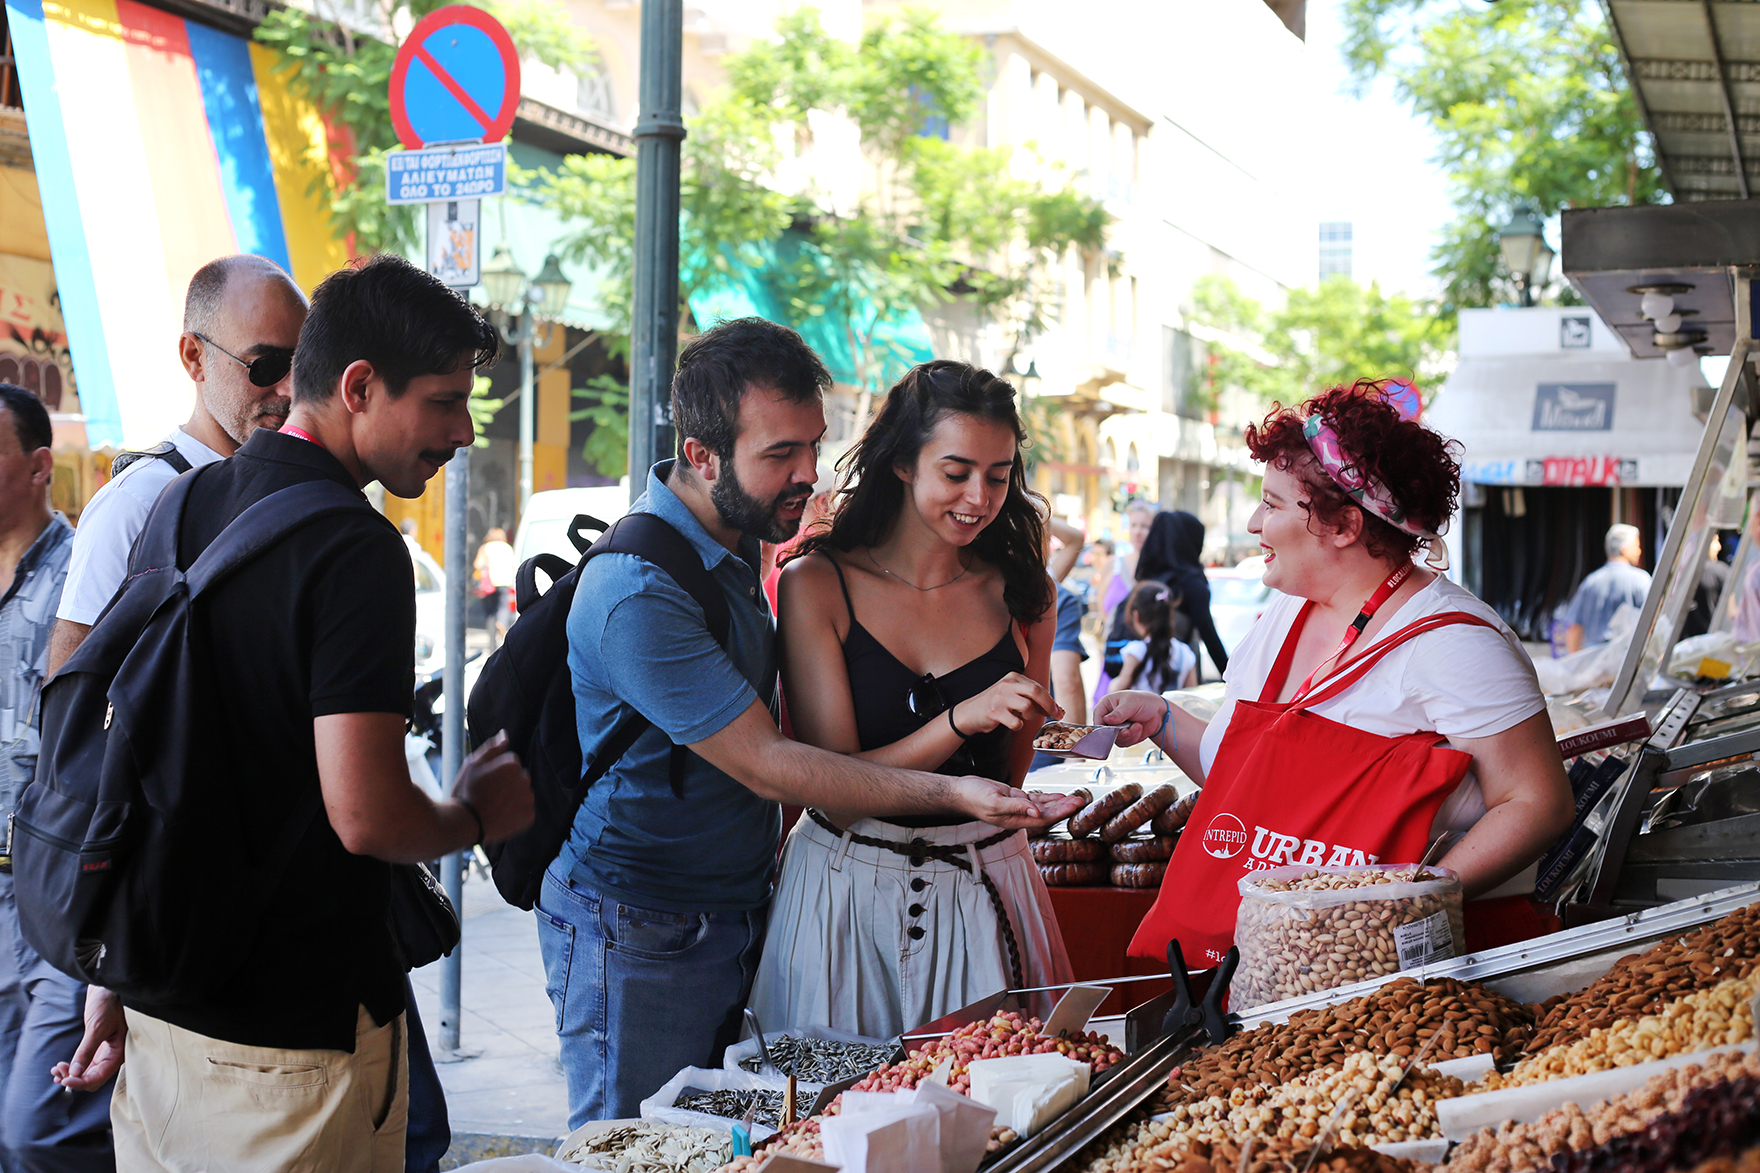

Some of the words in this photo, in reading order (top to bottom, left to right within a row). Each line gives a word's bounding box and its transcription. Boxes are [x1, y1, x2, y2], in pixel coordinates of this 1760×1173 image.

[400, 165, 495, 185] ΑΛΙΕΥΜΑΤΩΝ
[400, 184, 428, 199] ΟΛΟ
[432, 183, 451, 197] ΤΟ
[455, 179, 495, 195] 24ΩΡΟ
[1560, 728, 1617, 751] LOUKOUMI
[1575, 780, 1600, 816] UKOUMI
[1203, 829, 1248, 844] INTREPID
[1538, 849, 1575, 893] LOUKOUMI
